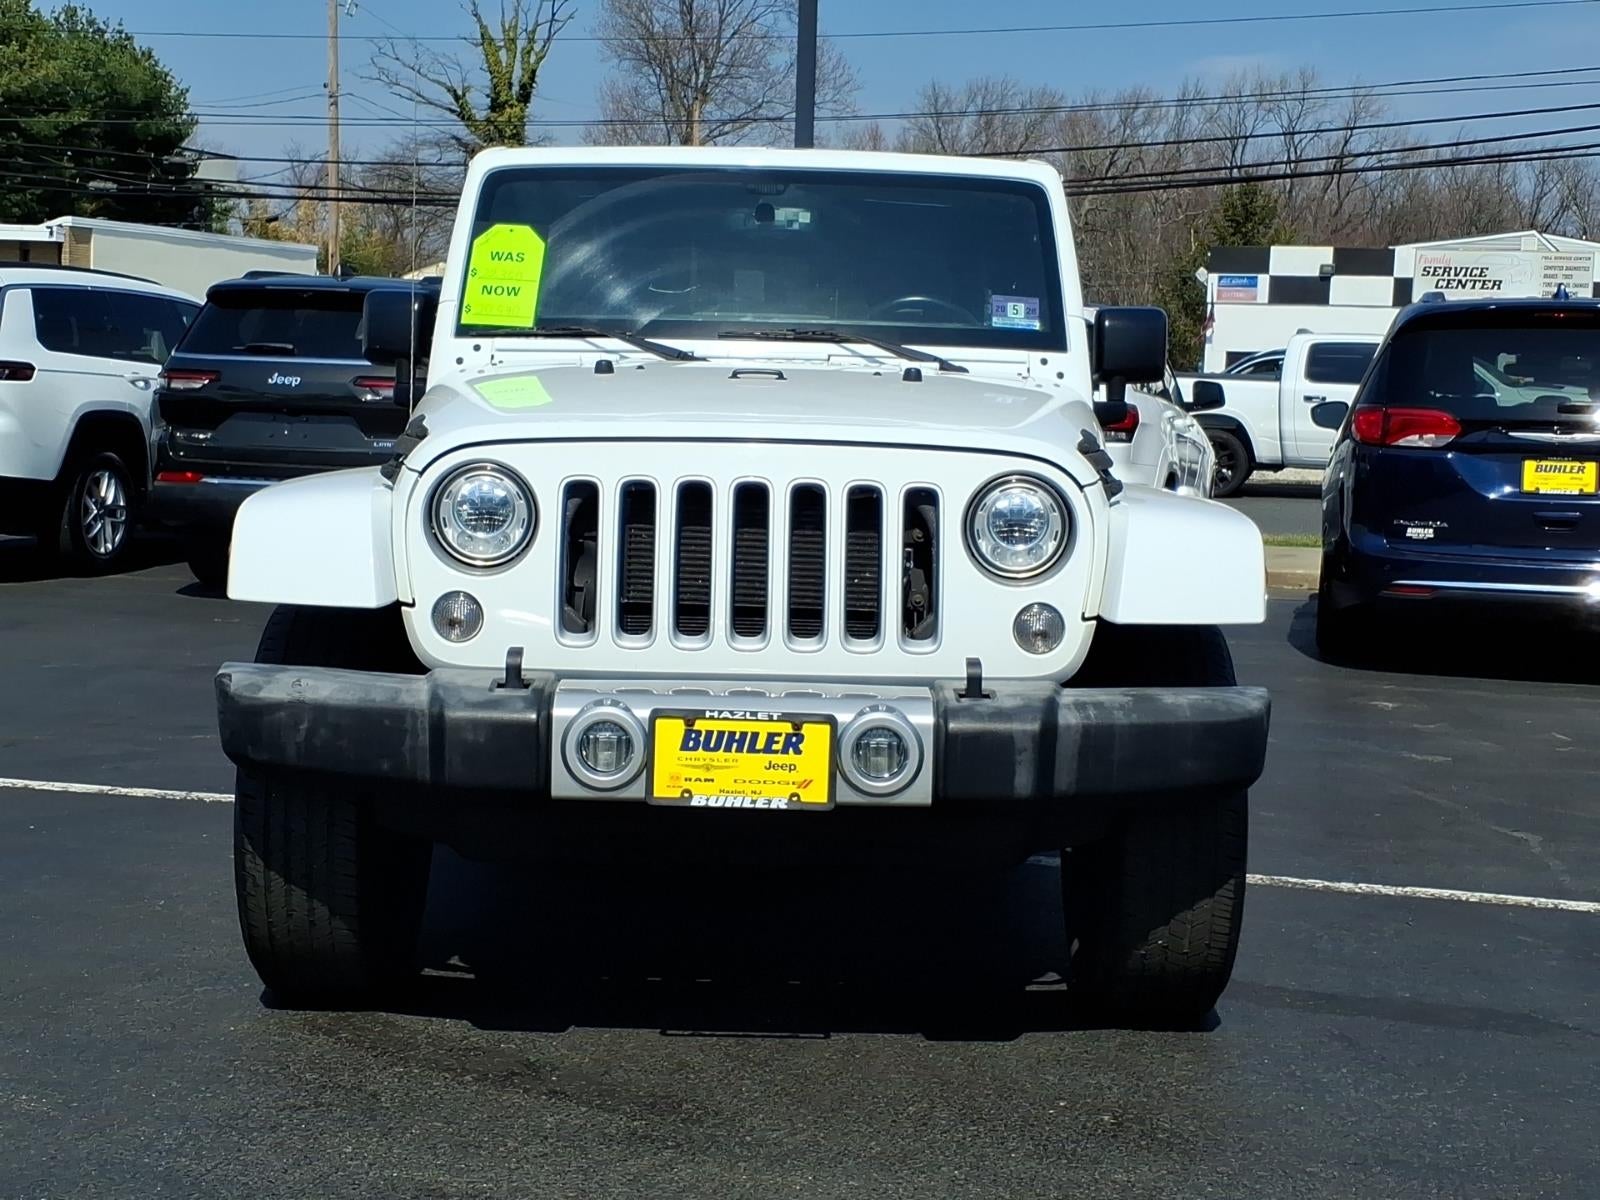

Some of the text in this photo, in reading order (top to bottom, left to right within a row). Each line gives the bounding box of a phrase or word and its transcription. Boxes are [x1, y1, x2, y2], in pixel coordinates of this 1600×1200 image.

[490, 250, 525, 263] WAS
[1418, 253, 1452, 266] Family
[470, 267, 478, 278] $
[1421, 266, 1489, 278] SERVICE
[1434, 278, 1503, 290] CENTER
[481, 284, 521, 297] NOW
[464, 303, 472, 314] $
[995, 304, 1006, 313] 20
[1012, 304, 1019, 315] 5
[267, 372, 301, 387] Jeep
[1535, 464, 1587, 474] BUHLER
[705, 710, 782, 721] HAZLET
[679, 728, 806, 756] BUHLER
[764, 760, 797, 773] Jeep
[733, 778, 803, 786] DODGE
[718, 788, 748, 796] Hazlet,
[690, 795, 788, 809] BUHLER
